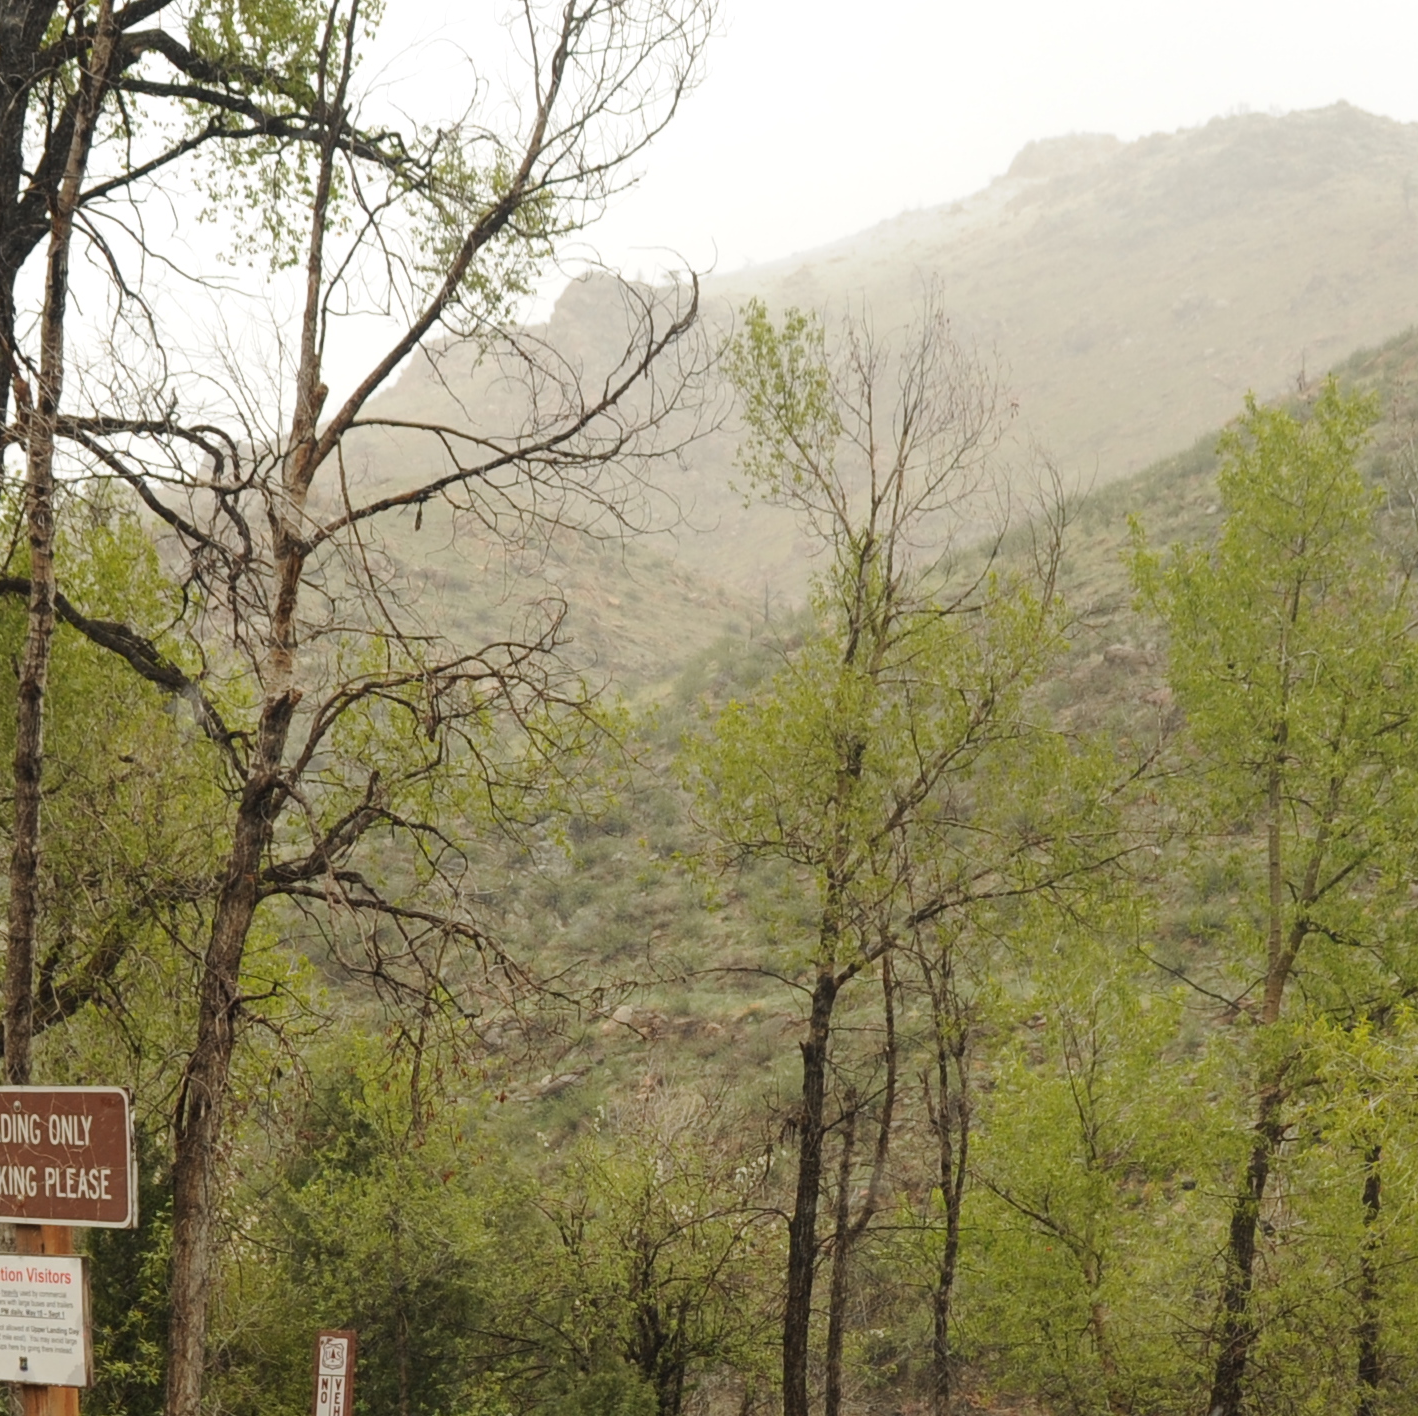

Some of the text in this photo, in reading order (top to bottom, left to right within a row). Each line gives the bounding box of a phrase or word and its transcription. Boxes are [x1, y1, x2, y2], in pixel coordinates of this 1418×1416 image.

[48, 1114, 93, 1146] ONLY
[44, 1167, 112, 1200] PLEASE
[26, 1267, 72, 1285] Visitors
[31, 1290, 38, 1298] by
[18, 1299, 31, 1308] large
[5, 1324, 24, 1332] allowed
[46, 1327, 68, 1336] Landing
[68, 1327, 80, 1336] Day
[40, 1336, 50, 1344] may
[65, 1337, 78, 1346] large
[20, 1344, 27, 1352] by
[27, 1346, 41, 1354] going
[320, 1377, 329, 1404] NO
